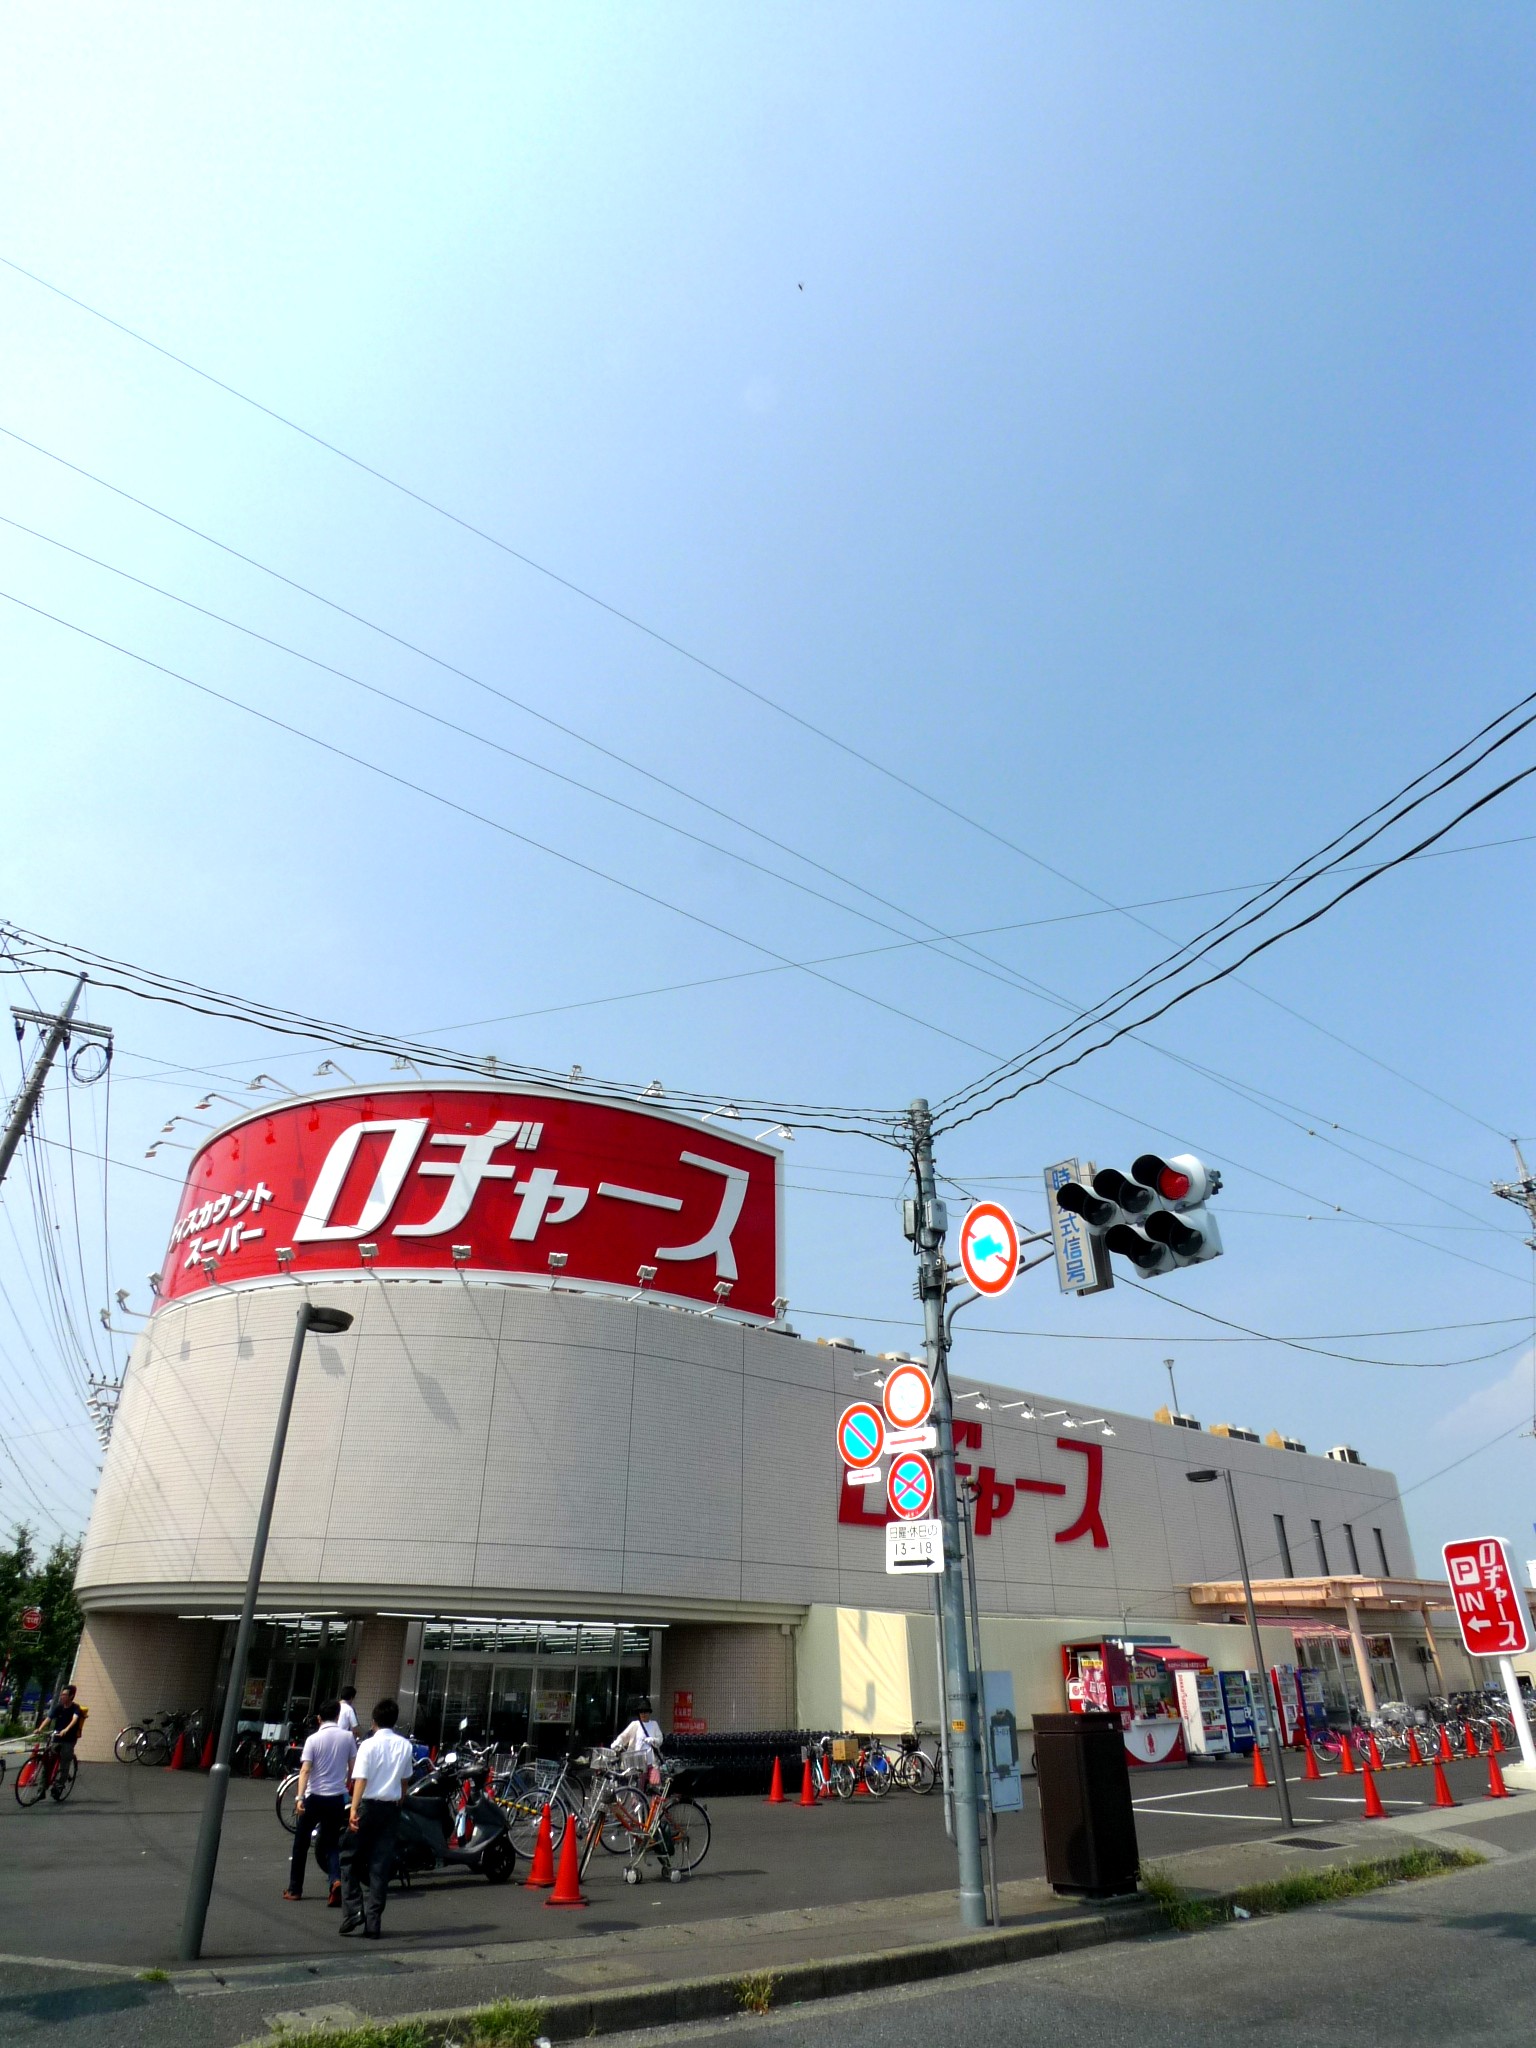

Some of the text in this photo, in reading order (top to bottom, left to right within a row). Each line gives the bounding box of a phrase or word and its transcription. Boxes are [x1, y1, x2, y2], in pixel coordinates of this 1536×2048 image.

[184, 1221, 265, 1269] スーパー
[292, 1117, 749, 1281] ロヂャース
[1051, 1166, 1086, 1283] 時式信号
[1459, 1590, 1486, 1613] IN
[1479, 1542, 1518, 1647] ロヂャース
